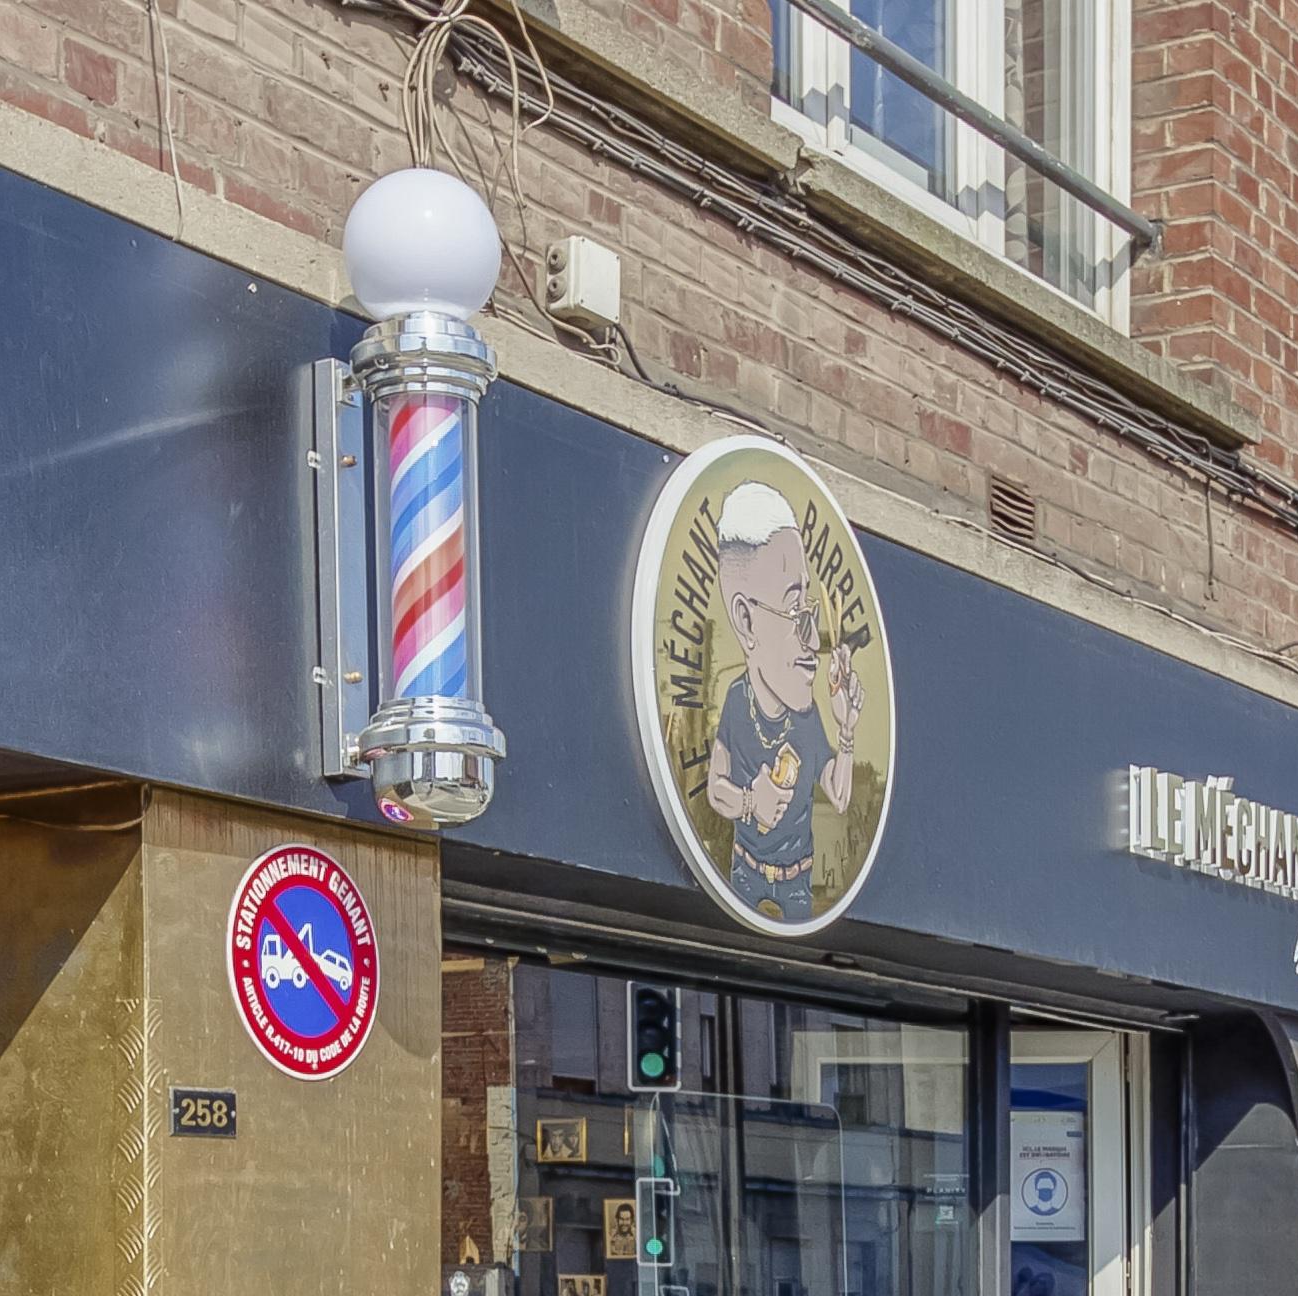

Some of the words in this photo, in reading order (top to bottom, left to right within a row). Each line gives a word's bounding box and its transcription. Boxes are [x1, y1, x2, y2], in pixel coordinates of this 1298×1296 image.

[672, 497, 719, 710] MÉCHANT
[236, 853, 329, 950] STATIONNEMENT
[328, 870, 371, 947] GENANT
[242, 977, 269, 1029] ARTICLE
[265, 1024, 305, 1062] R.417-10
[305, 1049, 318, 1064] DU
[319, 1039, 343, 1062] CODE
[339, 1028, 354, 1048] DE
[348, 1015, 362, 1034] LA
[355, 976, 371, 1018] ROUTE
[180, 1097, 228, 1128] 258
